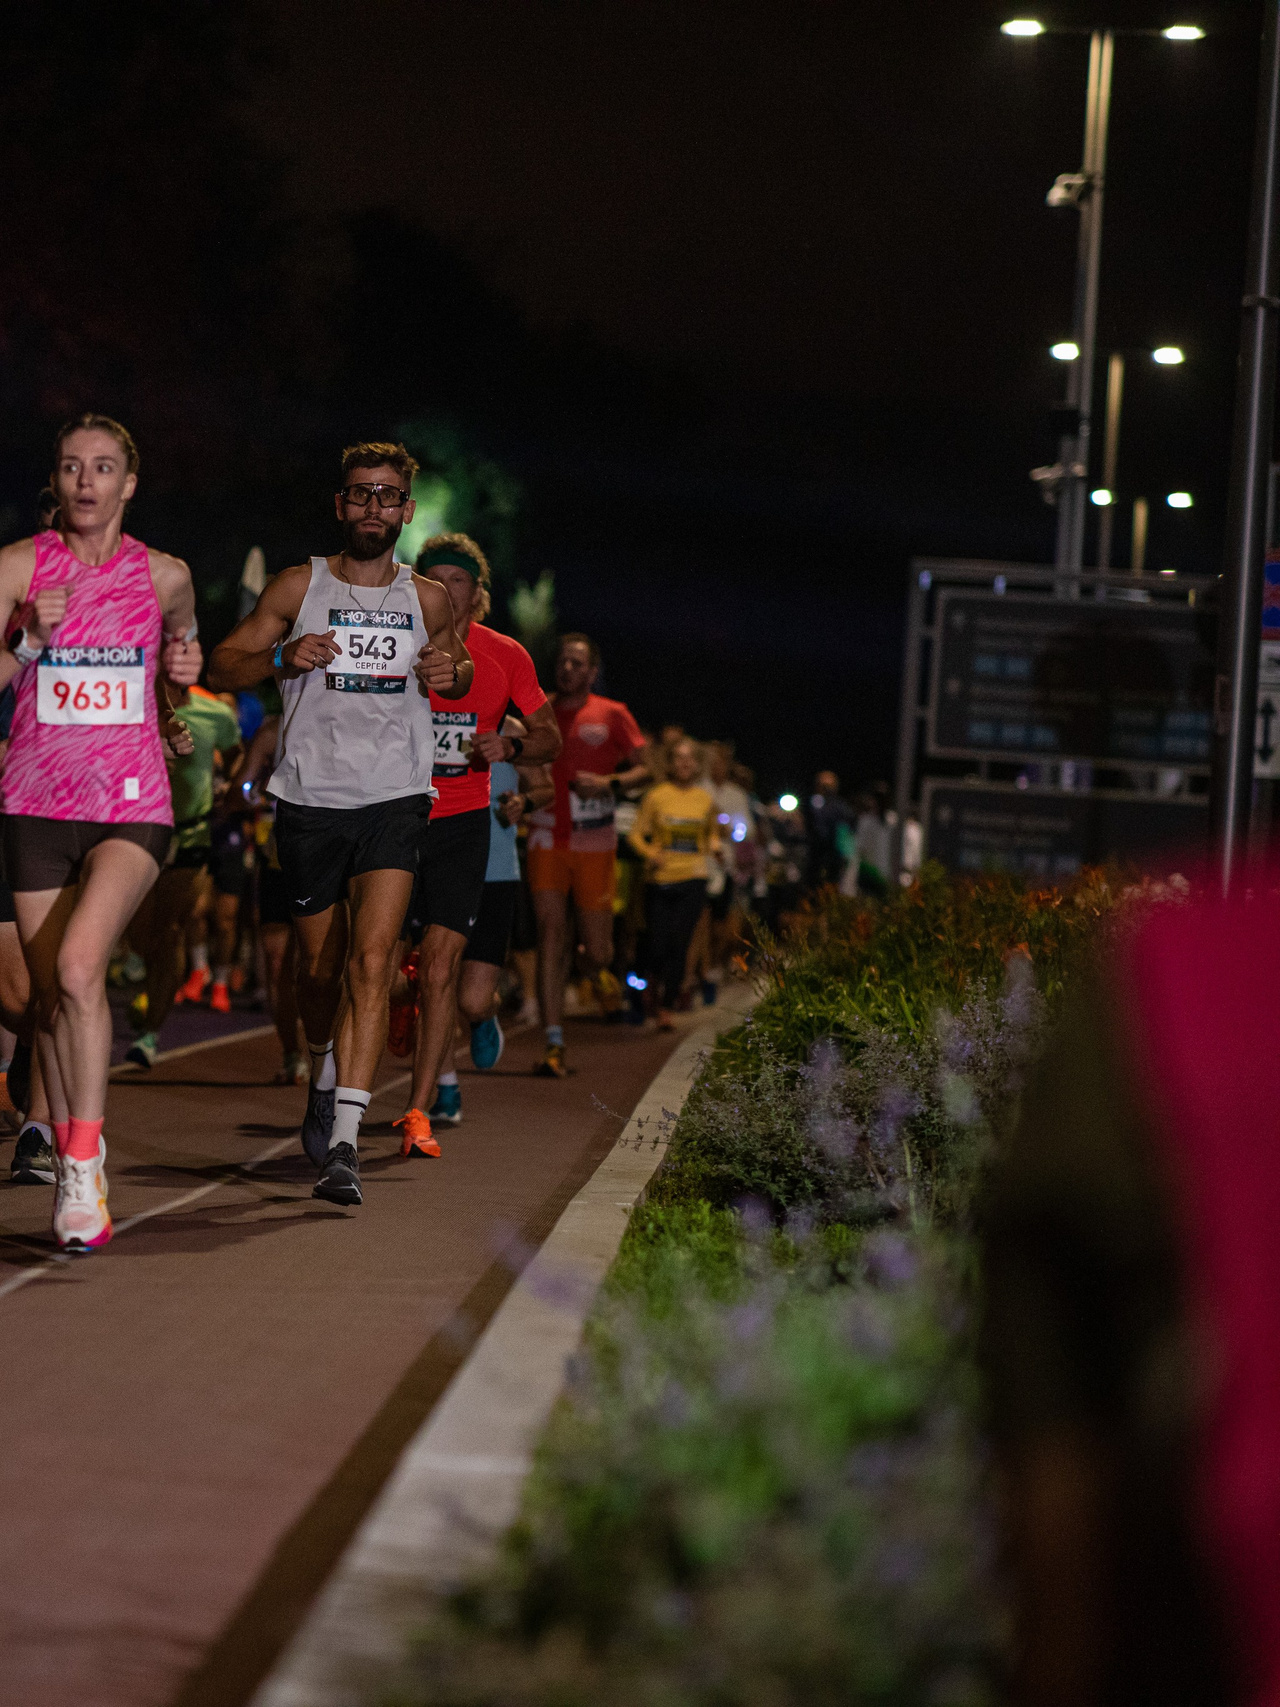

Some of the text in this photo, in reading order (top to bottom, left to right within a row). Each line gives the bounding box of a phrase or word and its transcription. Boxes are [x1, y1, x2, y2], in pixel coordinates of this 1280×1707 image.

[338, 610, 408, 625] НОЧНОЙ
[48, 645, 138, 663] НОЧНОЙ
[348, 633, 397, 660] 543
[355, 662, 387, 671] СЕРГЕЙ
[53, 681, 127, 711] 9631
